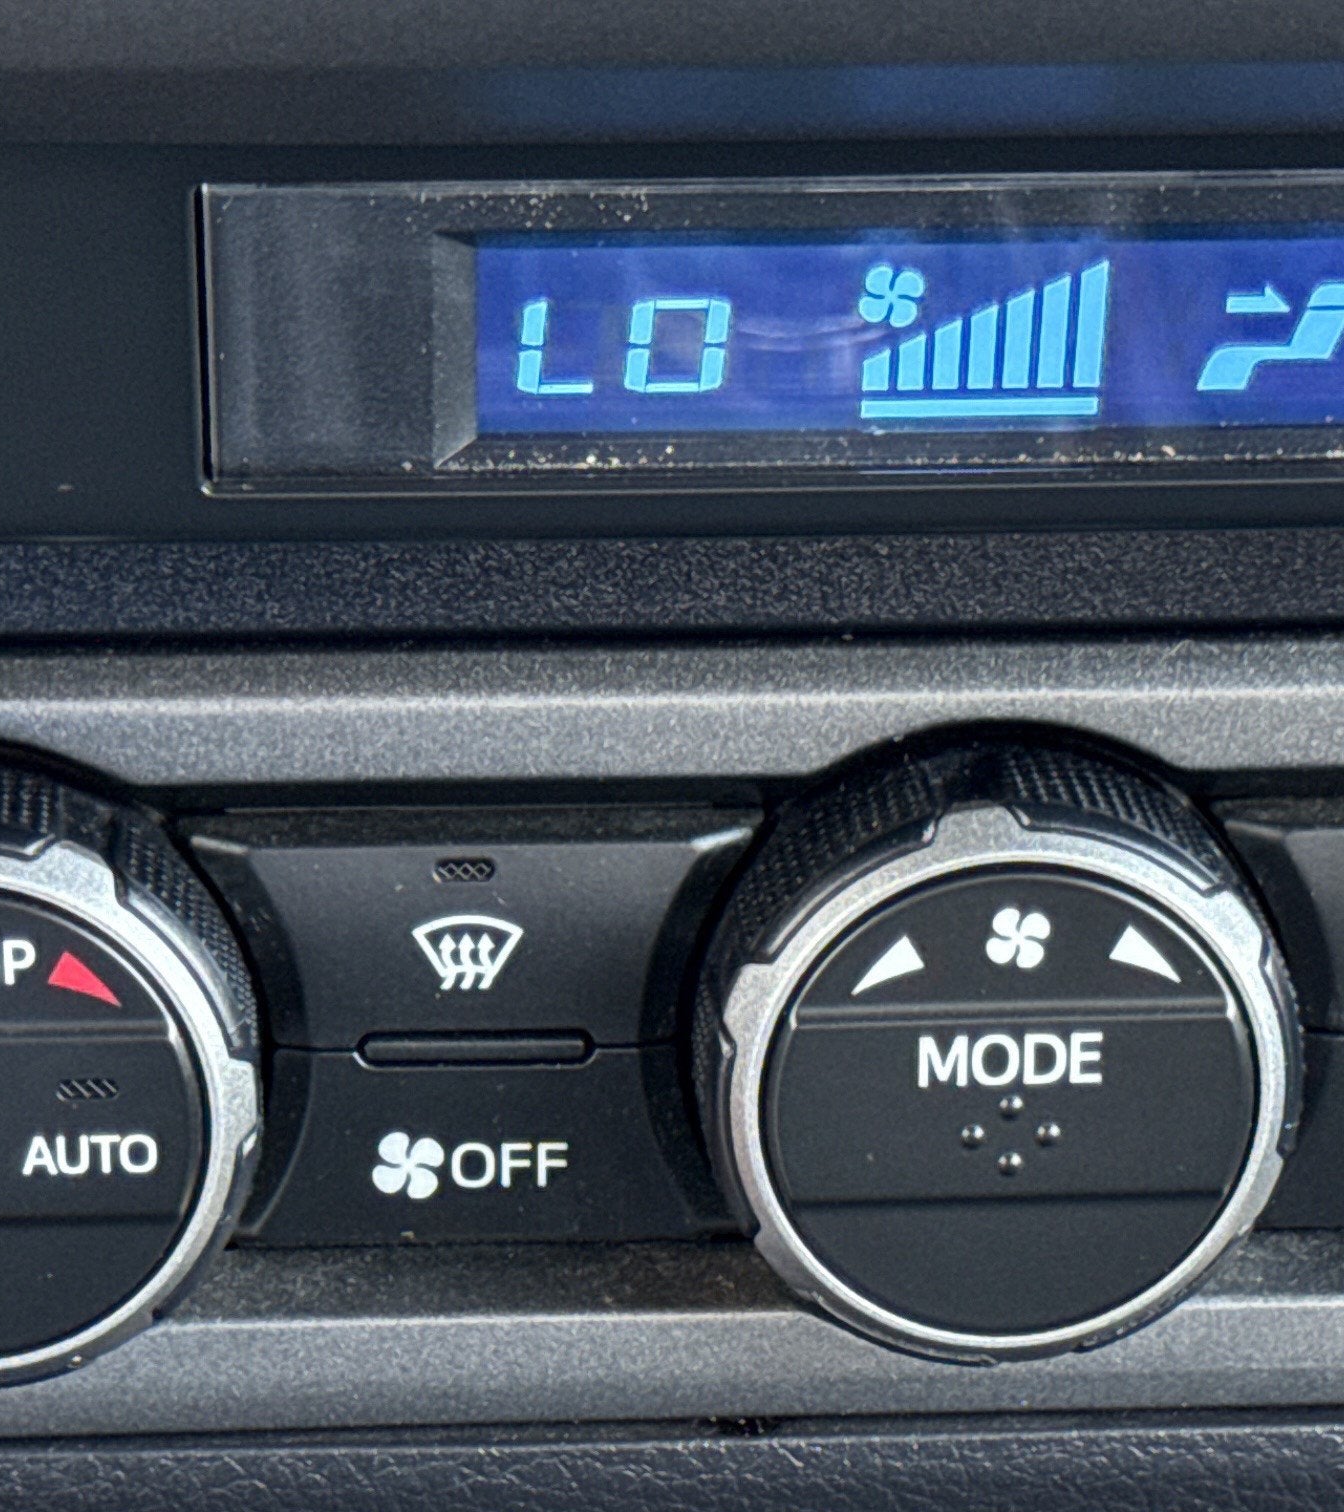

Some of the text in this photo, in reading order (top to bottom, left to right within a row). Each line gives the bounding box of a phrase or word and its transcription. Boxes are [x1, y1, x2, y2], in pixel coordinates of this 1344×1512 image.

[917, 1031, 1104, 1088] MODE
[22, 1133, 158, 1176] AUTO
[451, 1142, 568, 1189] OFF
